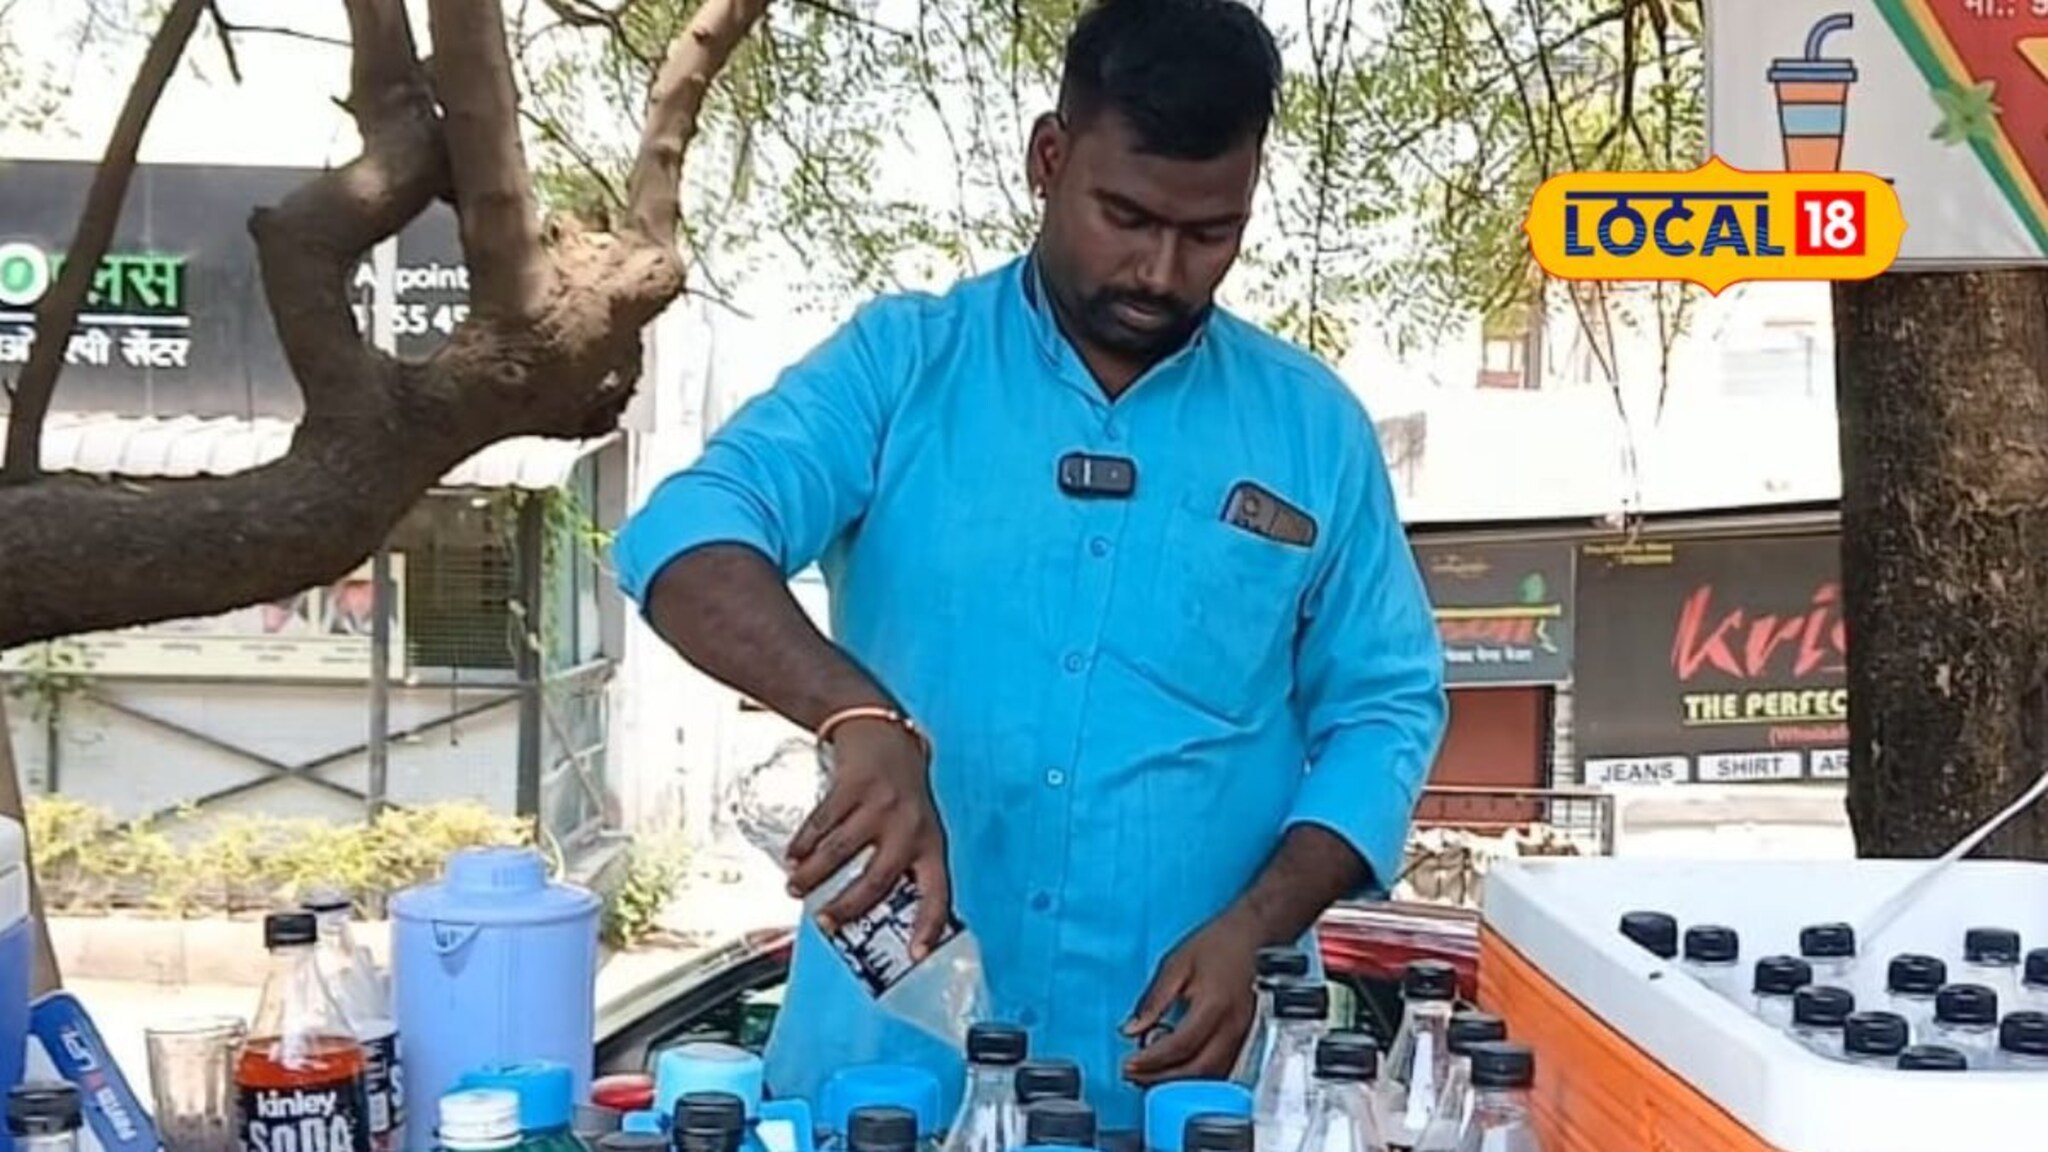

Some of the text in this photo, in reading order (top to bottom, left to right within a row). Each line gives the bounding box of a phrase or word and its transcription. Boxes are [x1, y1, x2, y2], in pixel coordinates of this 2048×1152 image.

[354, 262, 470, 295] Apoint
[120, 328, 191, 367] सेंटर
[1683, 693, 1738, 719] THE
[1601, 762, 1674, 782] JEANS
[1717, 757, 1784, 777] SHIRT
[256, 1089, 337, 1118] kinley
[250, 1114, 354, 1152] SODA
